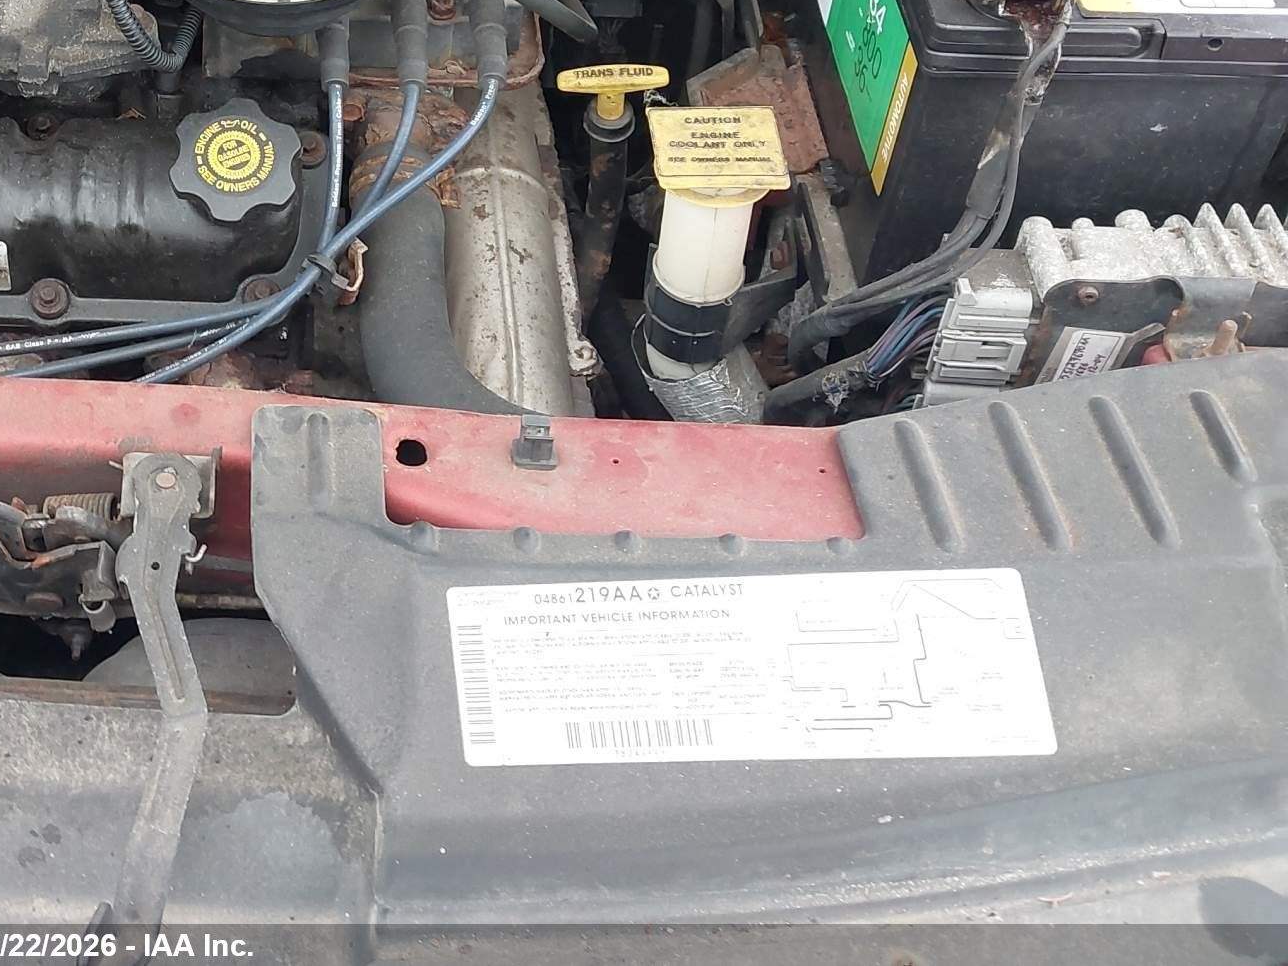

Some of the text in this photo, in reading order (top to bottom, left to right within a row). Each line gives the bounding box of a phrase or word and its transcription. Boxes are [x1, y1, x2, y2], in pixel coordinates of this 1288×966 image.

[863, 22, 882, 79] 800
[574, 66, 654, 79] TRANS FLUID
[684, 116, 742, 124] CAUTION
[881, 72, 909, 164] AUTOMOTIVE
[195, 120, 258, 155] ENGINE OIL
[691, 131, 741, 139] ENGINE
[217, 143, 250, 162] GASOLINE
[223, 139, 238, 151] FOR
[669, 140, 766, 149] COOLANT ONLY
[197, 141, 275, 192] SEE OWNERS MANUAL
[670, 583, 743, 598] CATALYST
[504, 609, 731, 626] IMPORTANT VEHICLE INFORMATION
